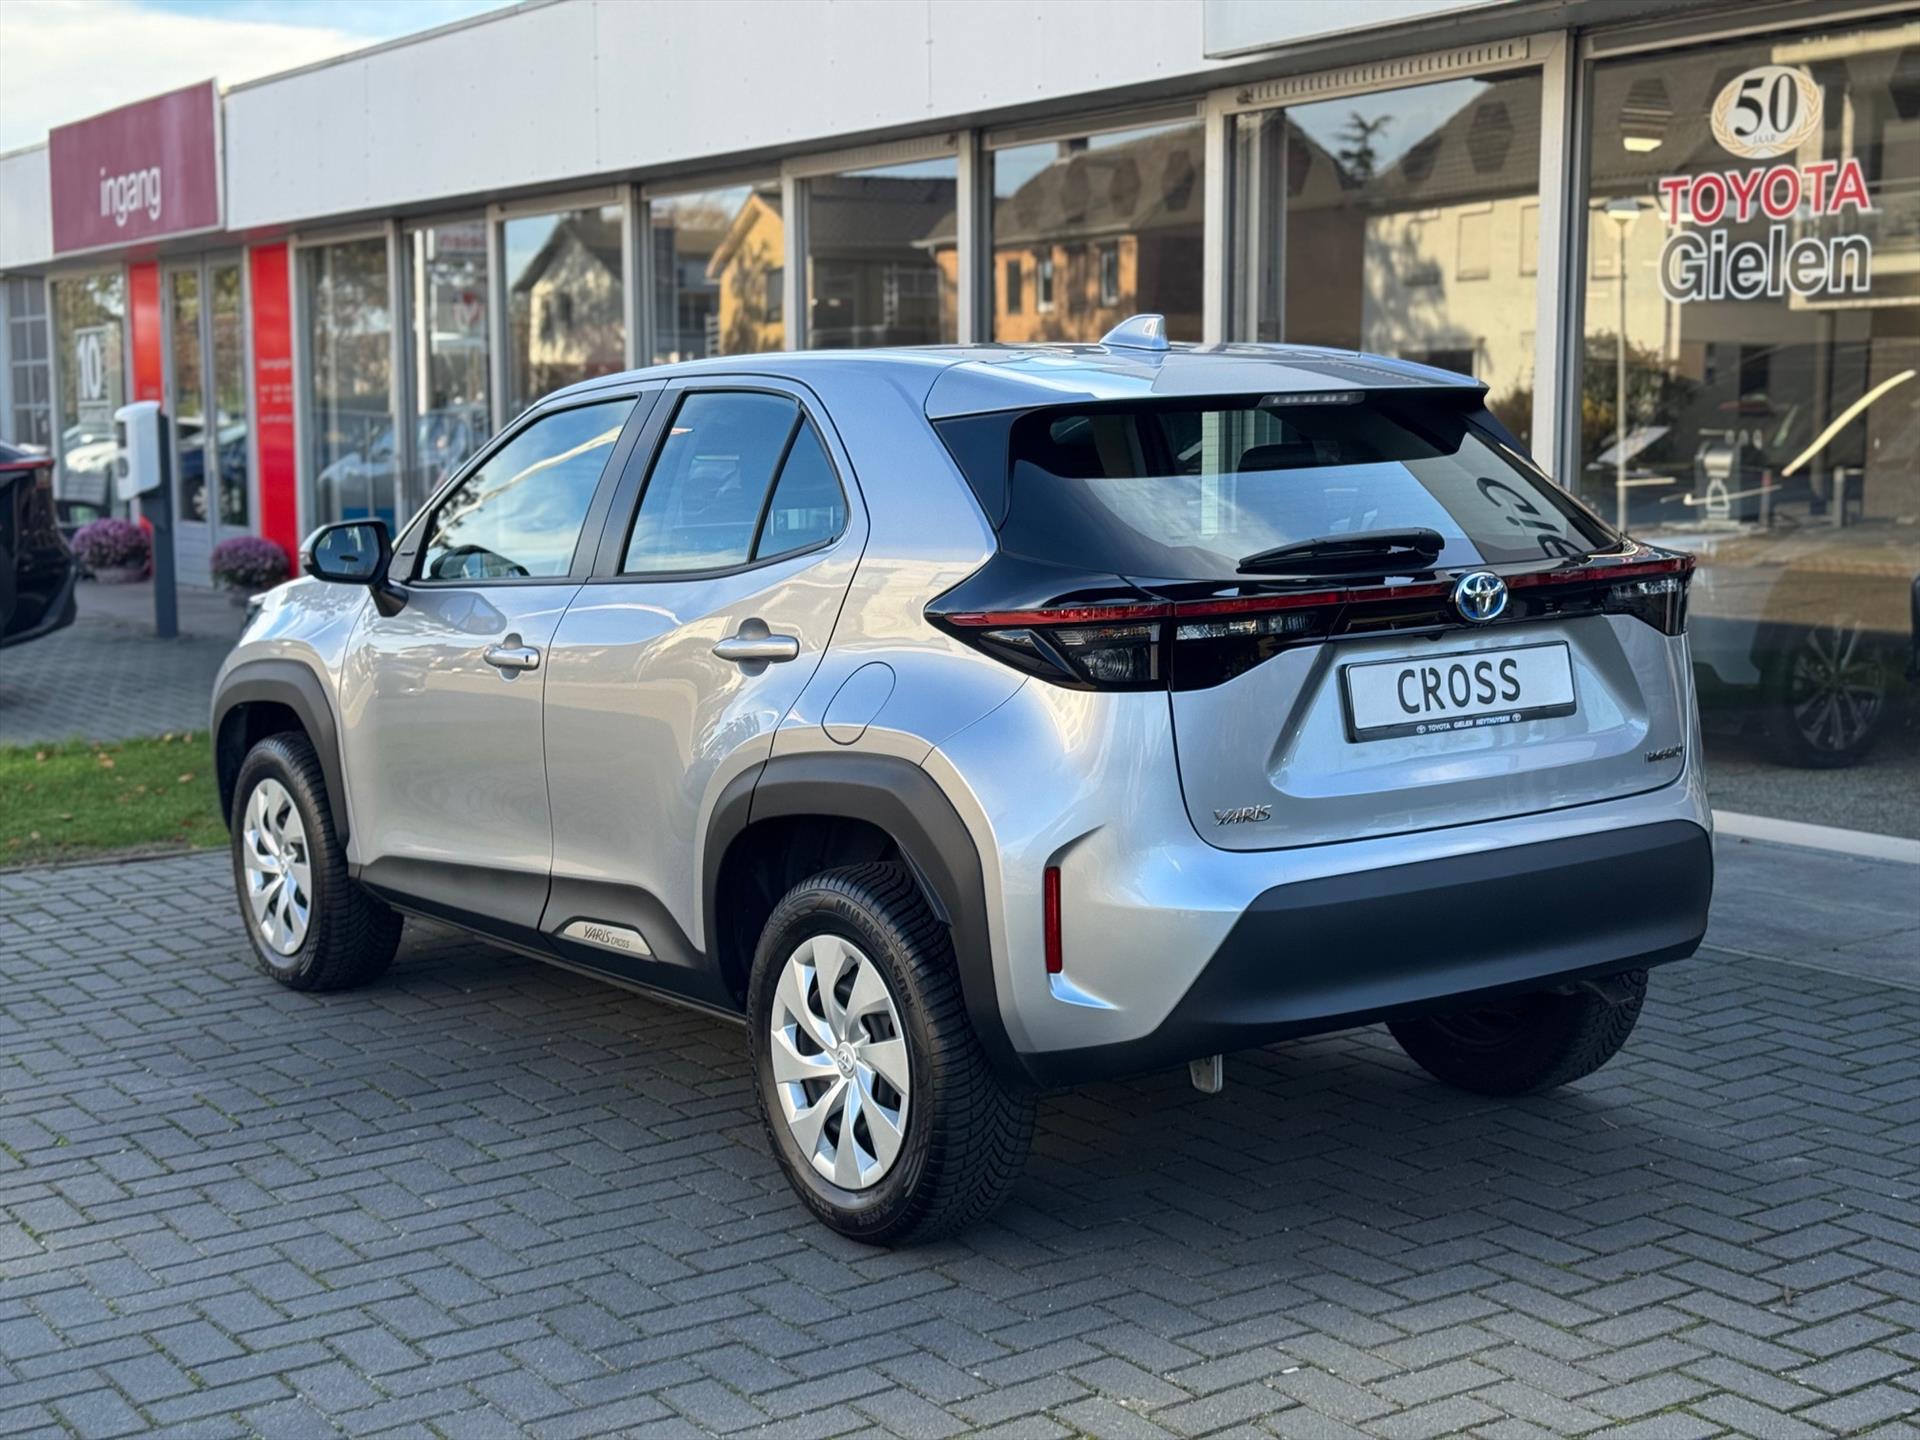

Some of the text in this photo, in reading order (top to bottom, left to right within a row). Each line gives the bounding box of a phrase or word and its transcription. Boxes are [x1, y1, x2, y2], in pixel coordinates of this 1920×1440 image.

[1734, 73, 1798, 136] 50
[1752, 133, 1777, 145] JAAR
[99, 167, 162, 226] ingang
[1658, 159, 1872, 226] TOYOTA
[1658, 225, 1872, 304] Gielen
[1397, 658, 1521, 713] CROSS
[1428, 722, 1451, 732] TOYOTA
